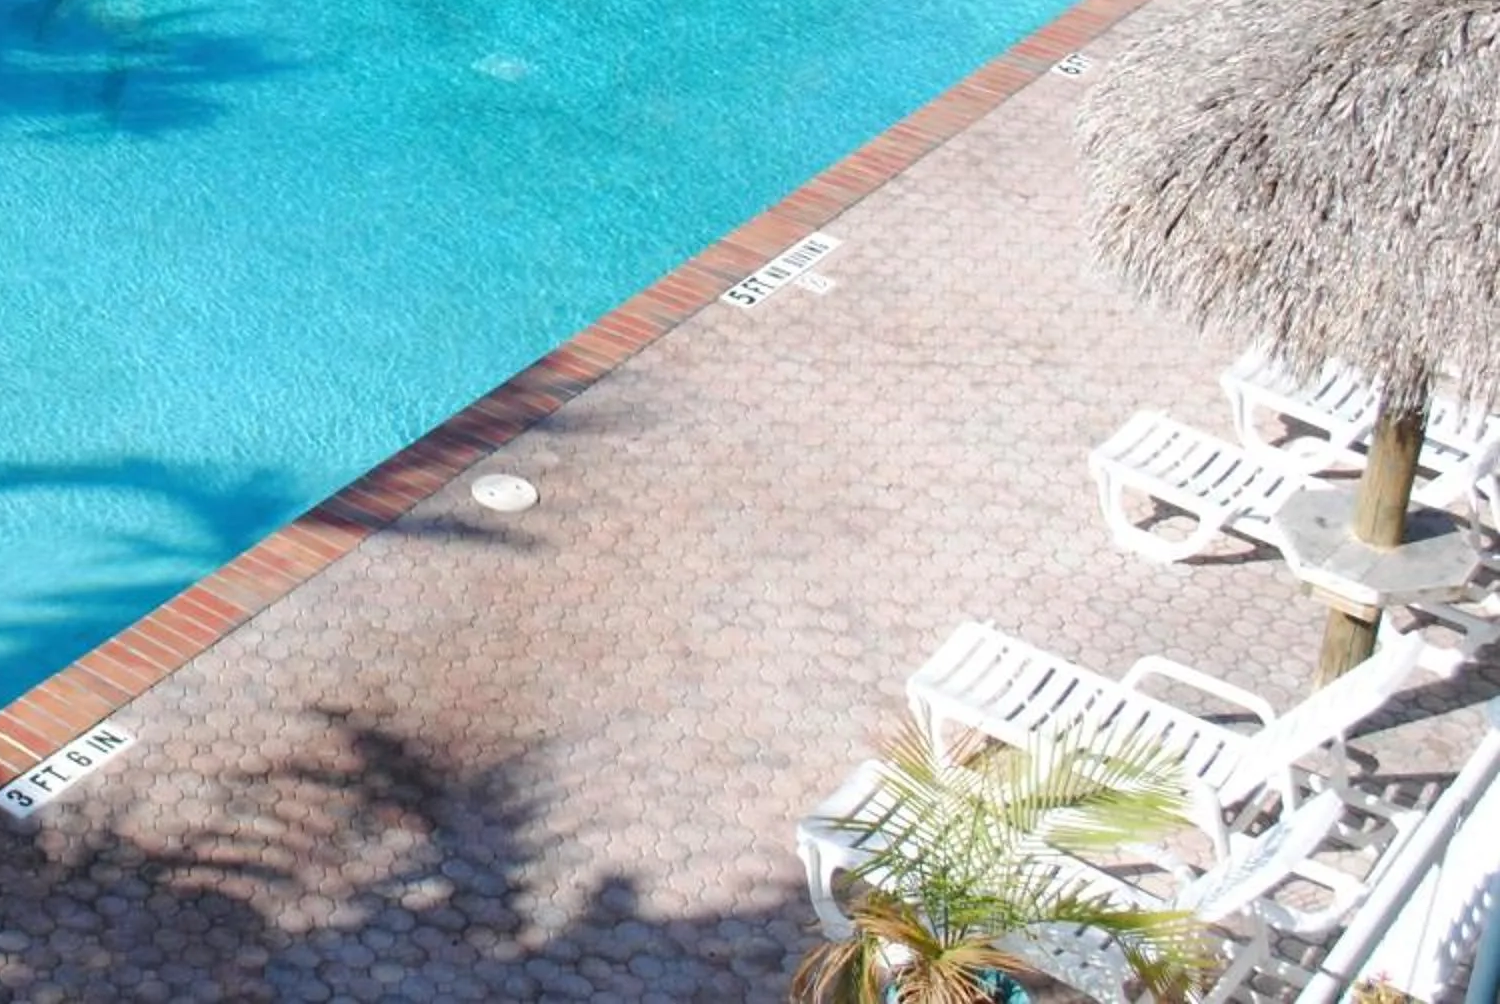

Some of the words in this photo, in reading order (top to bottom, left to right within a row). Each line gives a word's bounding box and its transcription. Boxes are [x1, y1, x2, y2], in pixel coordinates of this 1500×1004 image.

[741, 277, 776, 295] FT
[728, 290, 756, 305] 5
[6, 789, 34, 807] 3
[29, 764, 70, 792] FT
[66, 750, 93, 767] 6
[85, 729, 128, 754] IN
